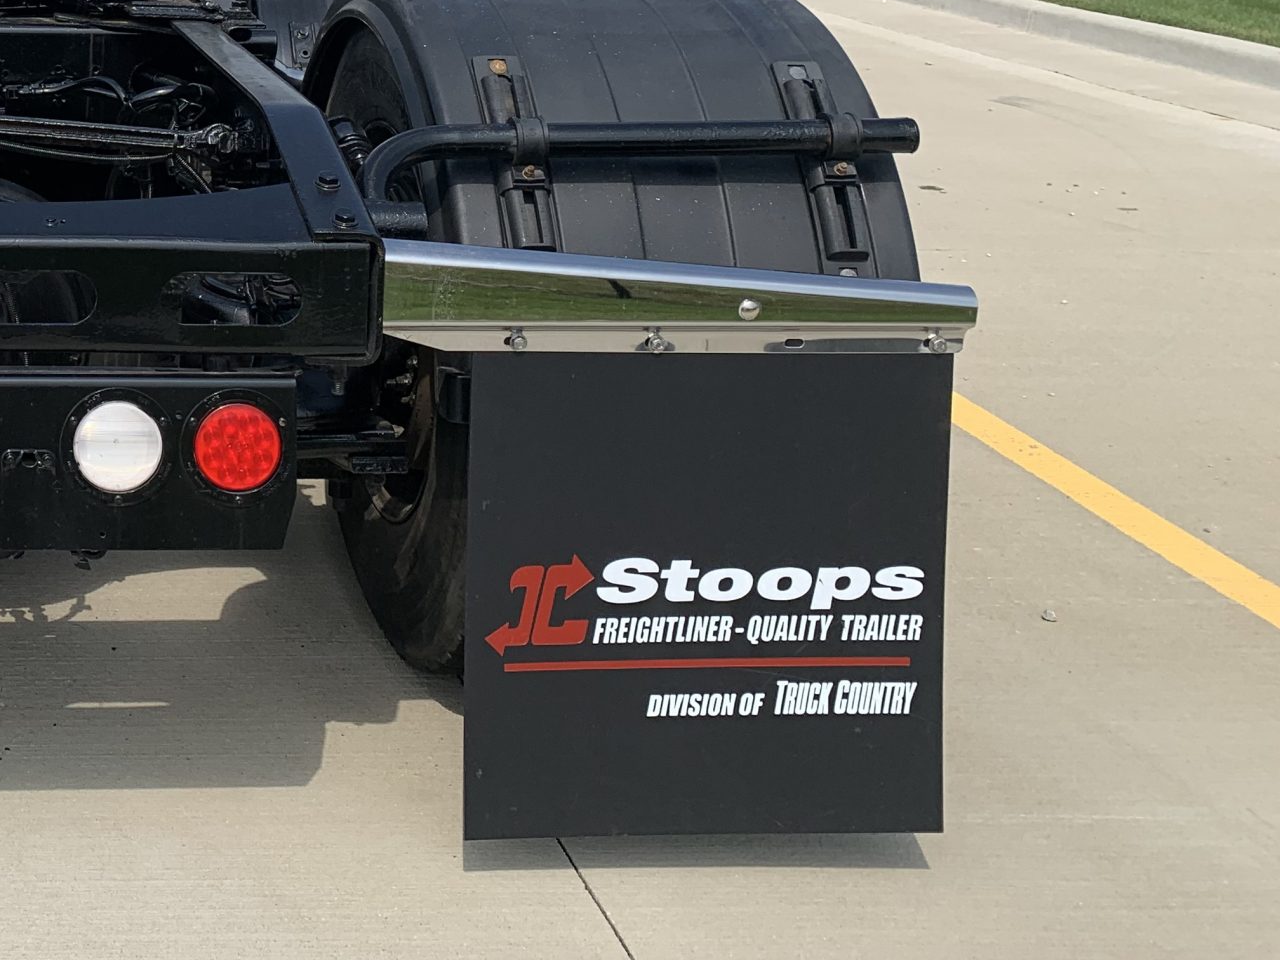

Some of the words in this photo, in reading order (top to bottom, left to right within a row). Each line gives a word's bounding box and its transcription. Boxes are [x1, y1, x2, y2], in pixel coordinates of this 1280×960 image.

[595, 557, 925, 610] Stoops
[841, 614, 924, 641] TRAILER
[647, 692, 737, 717] DIVISION
[738, 692, 766, 716] OF
[774, 680, 832, 715] TRUCK
[834, 679, 918, 715] COUNTRY
